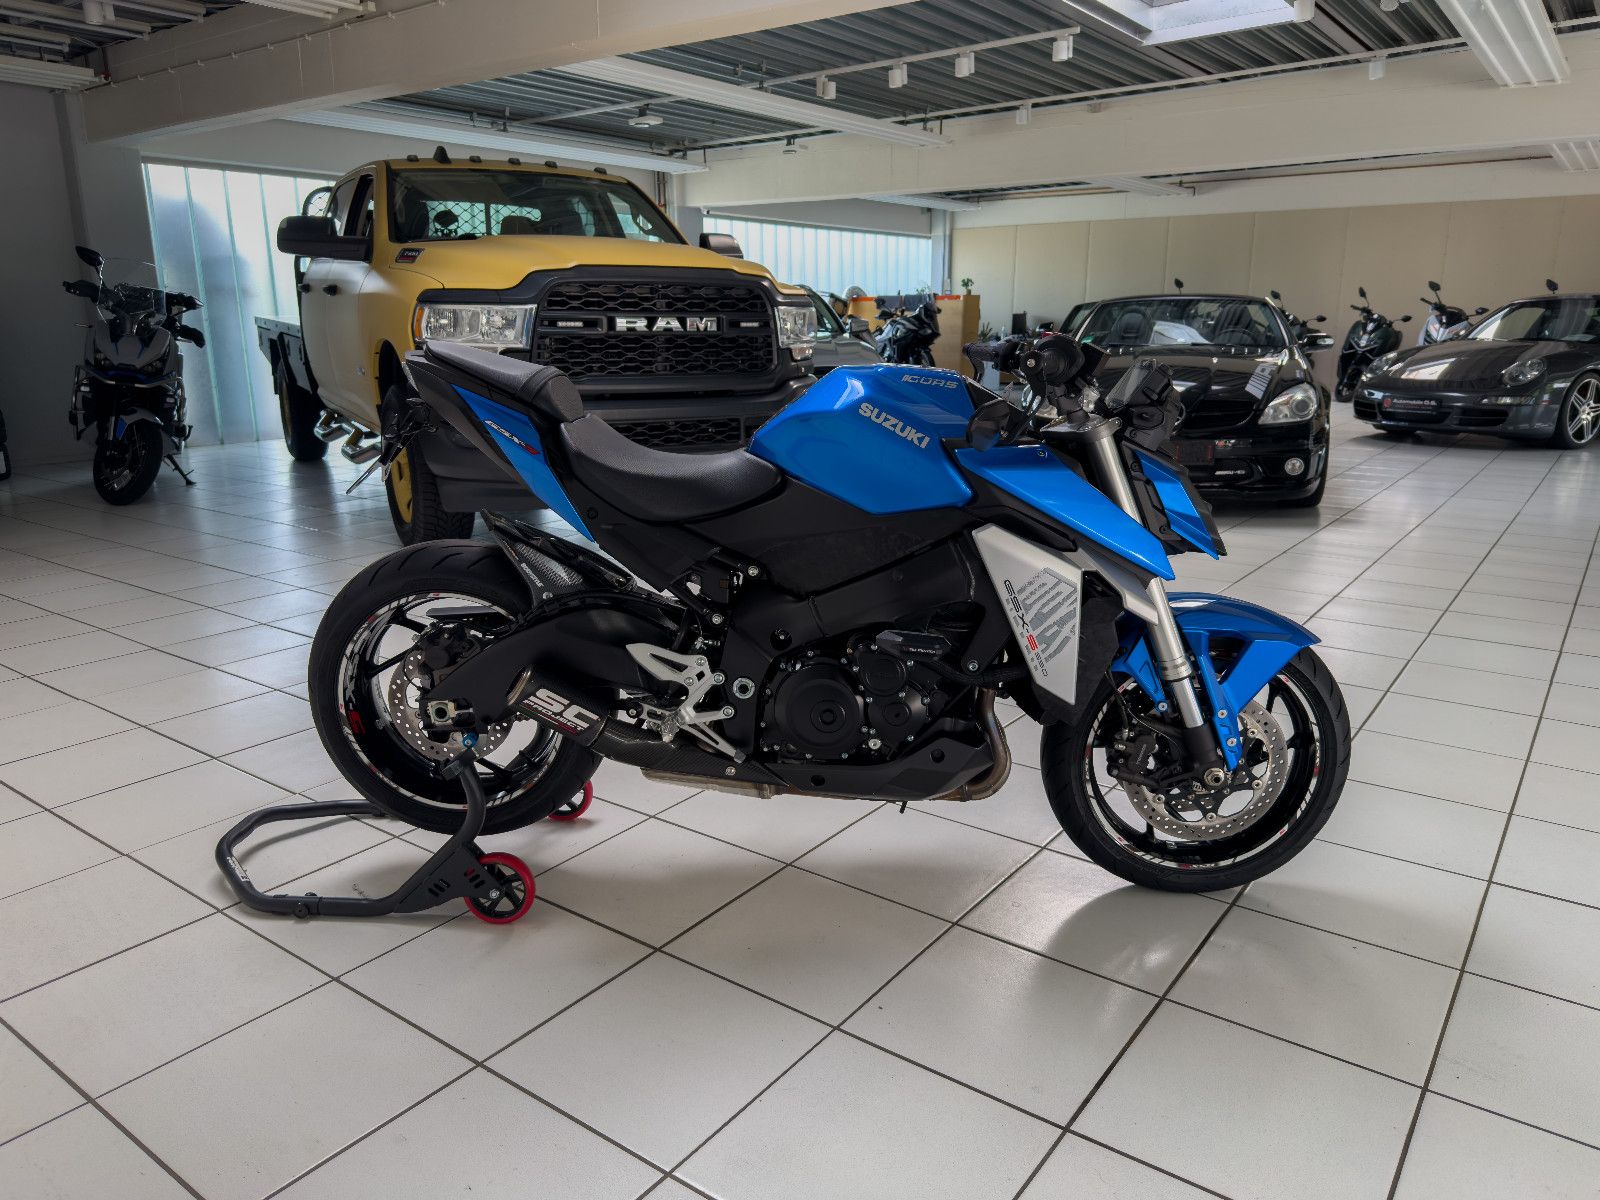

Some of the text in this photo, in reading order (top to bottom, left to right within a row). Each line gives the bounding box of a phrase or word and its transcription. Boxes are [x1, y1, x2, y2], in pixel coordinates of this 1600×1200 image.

[615, 317, 718, 331] RAM
[858, 402, 931, 449] SUZUKI
[522, 699, 585, 731] PROJECT
[527, 688, 600, 730] SC
